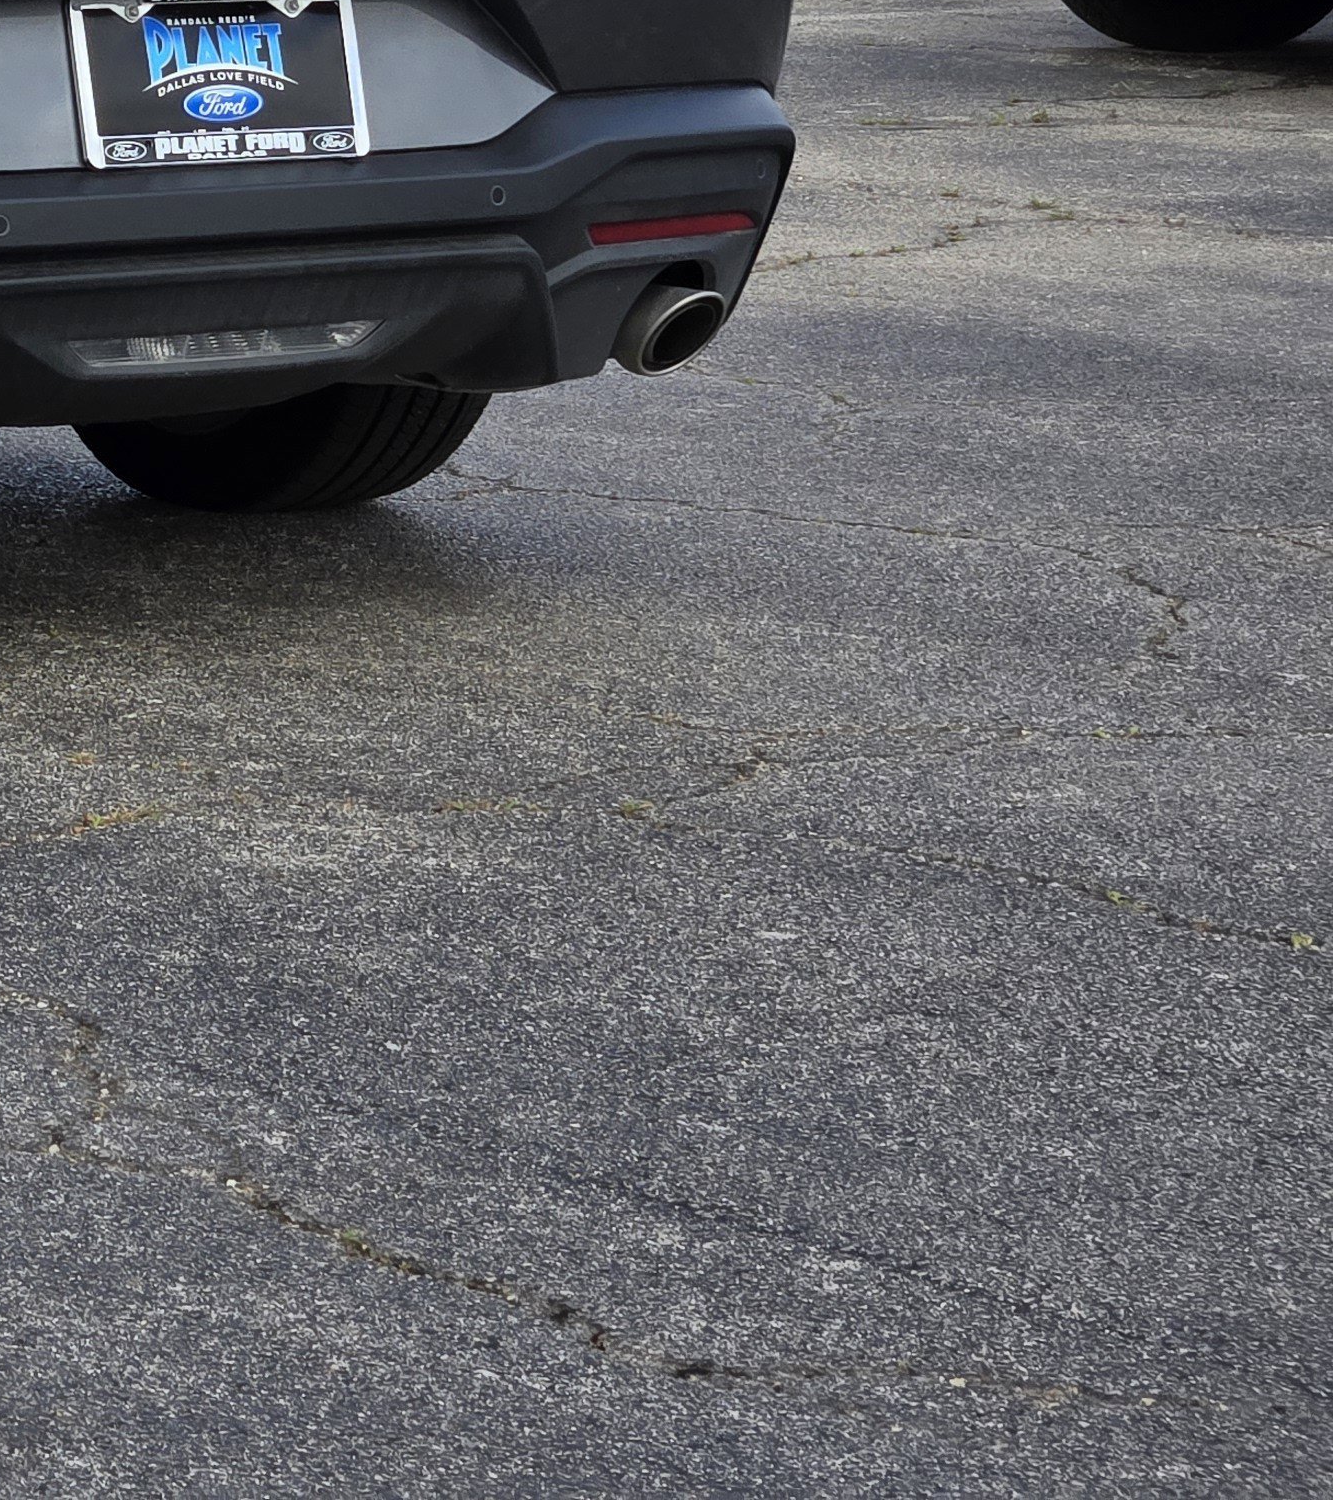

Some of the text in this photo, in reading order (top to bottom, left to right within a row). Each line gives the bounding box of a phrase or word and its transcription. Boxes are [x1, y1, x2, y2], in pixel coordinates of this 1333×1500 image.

[141, 15, 283, 86] PLANET
[157, 71, 285, 97] DALLAS LOVE FIELD
[198, 89, 247, 116] Ford
[154, 132, 306, 160] PLANET FORD
[187, 151, 268, 160] DALLAS
